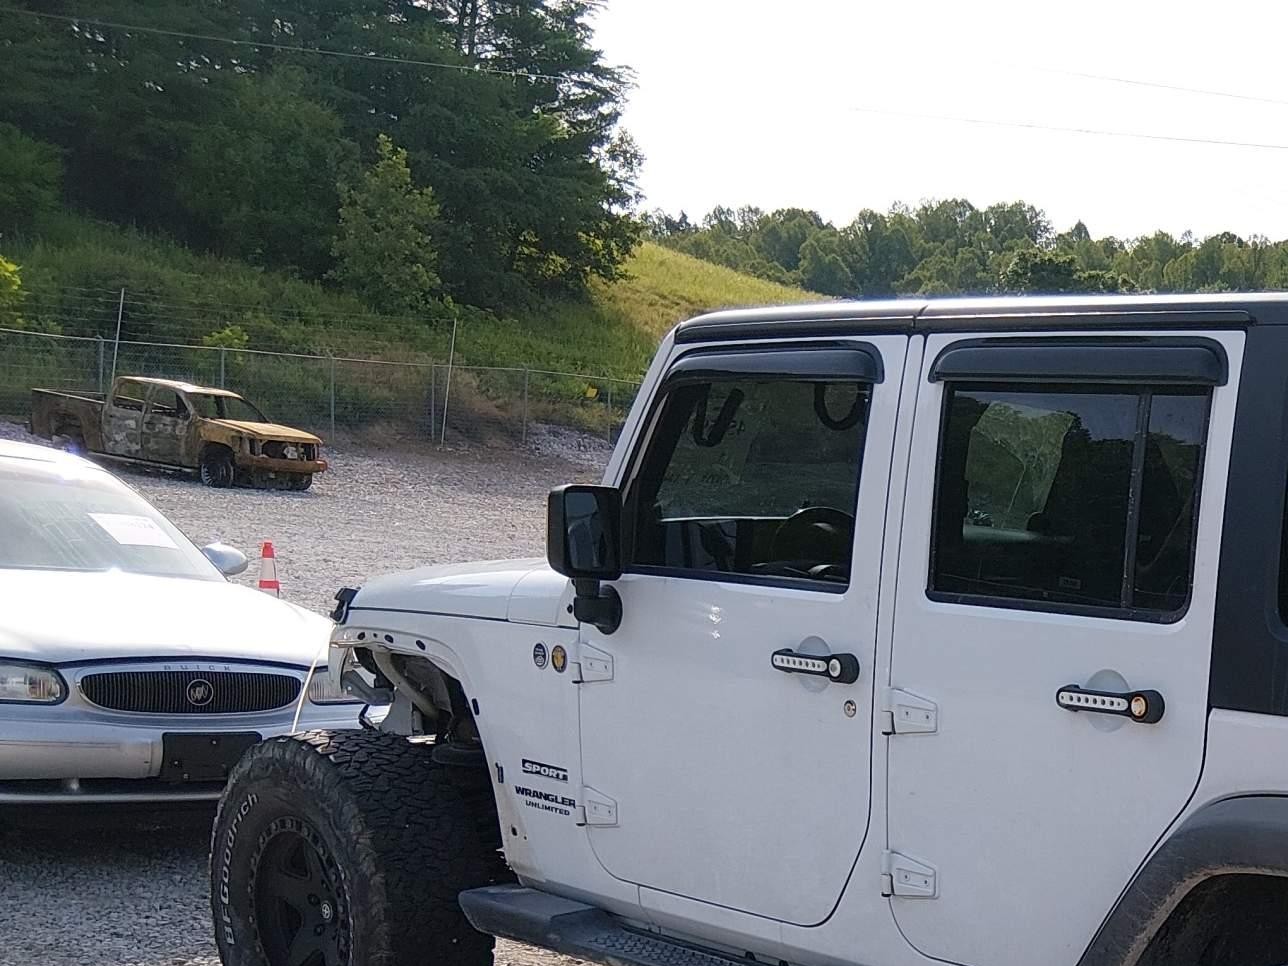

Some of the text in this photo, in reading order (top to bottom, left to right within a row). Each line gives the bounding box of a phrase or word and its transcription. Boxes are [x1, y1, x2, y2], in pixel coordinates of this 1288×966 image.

[163, 664, 231, 672] BUICK
[523, 761, 567, 781] SPORT
[514, 785, 576, 809] WRANGLER
[525, 800, 570, 816] UNLIMITED
[220, 793, 258, 945] BFGoodrich
